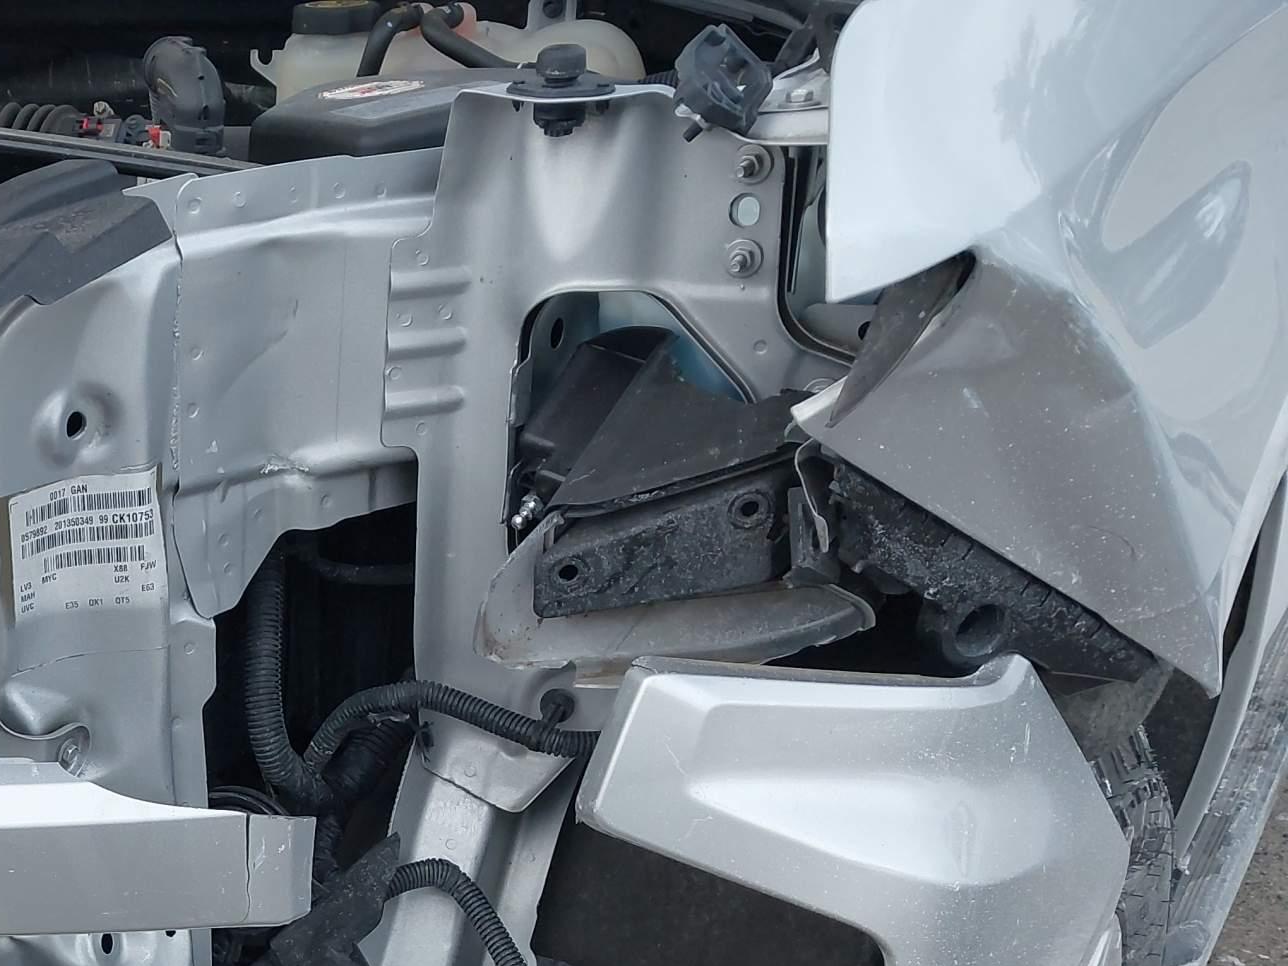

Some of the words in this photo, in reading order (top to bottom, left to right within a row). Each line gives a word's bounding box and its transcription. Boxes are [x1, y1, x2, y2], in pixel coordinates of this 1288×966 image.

[50, 488, 66, 501] 0017
[70, 484, 88, 495] GAN
[99, 514, 109, 524] 99
[112, 508, 154, 524] CK10753
[114, 575, 130, 584] U2K
[20, 582, 32, 593] LV3
[21, 602, 35, 614] UVC
